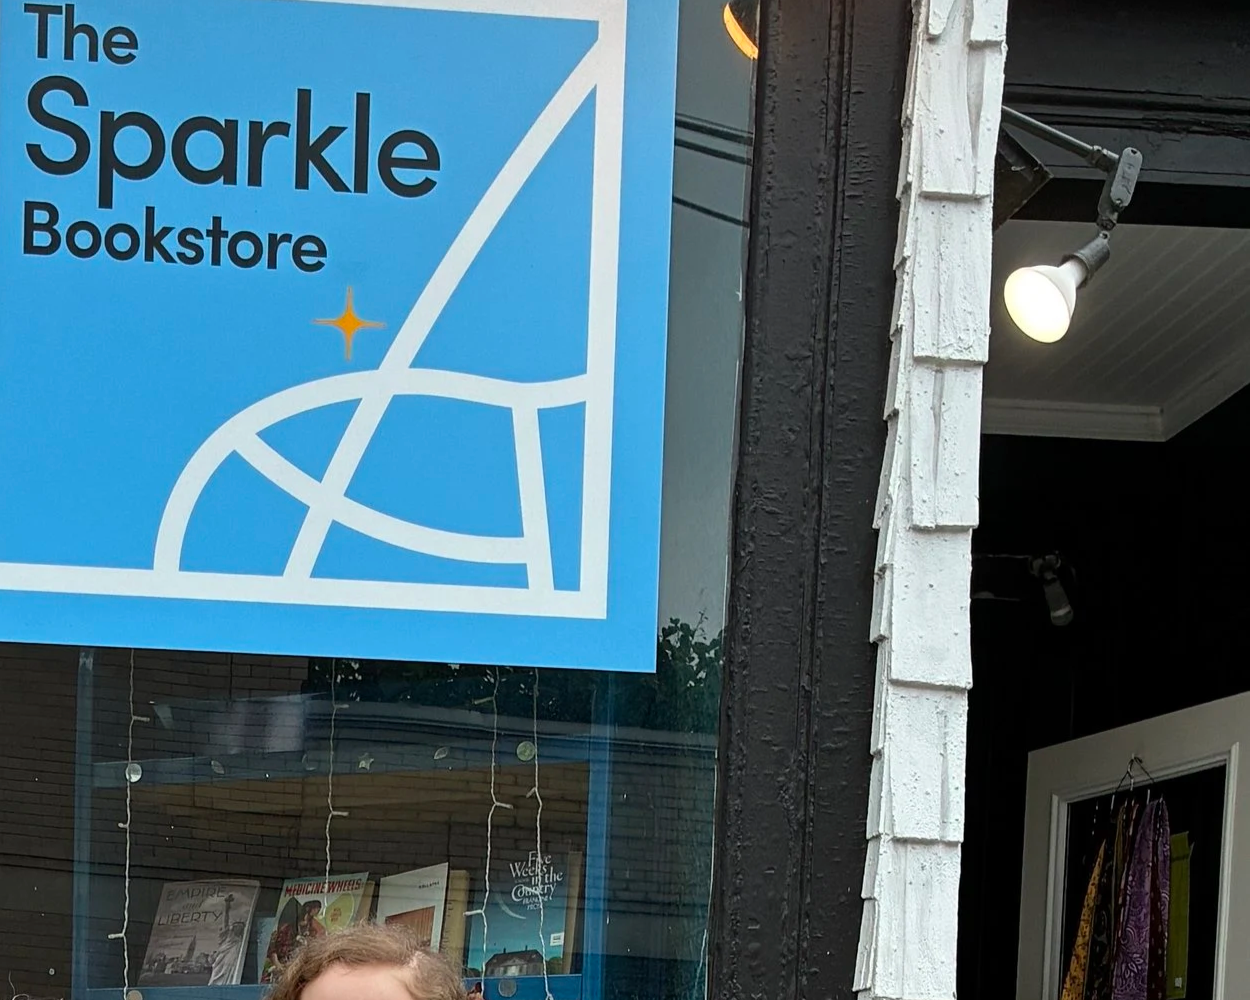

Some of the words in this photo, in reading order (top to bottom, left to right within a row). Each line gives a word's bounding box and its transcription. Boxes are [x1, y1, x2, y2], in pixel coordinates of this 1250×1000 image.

[23, 3, 139, 65] The
[25, 75, 441, 209] Sparkle
[22, 200, 328, 273] Bookstore
[166, 886, 227, 901] EMPIRE
[545, 866, 563, 883] the
[157, 911, 224, 926] LIBERTY
